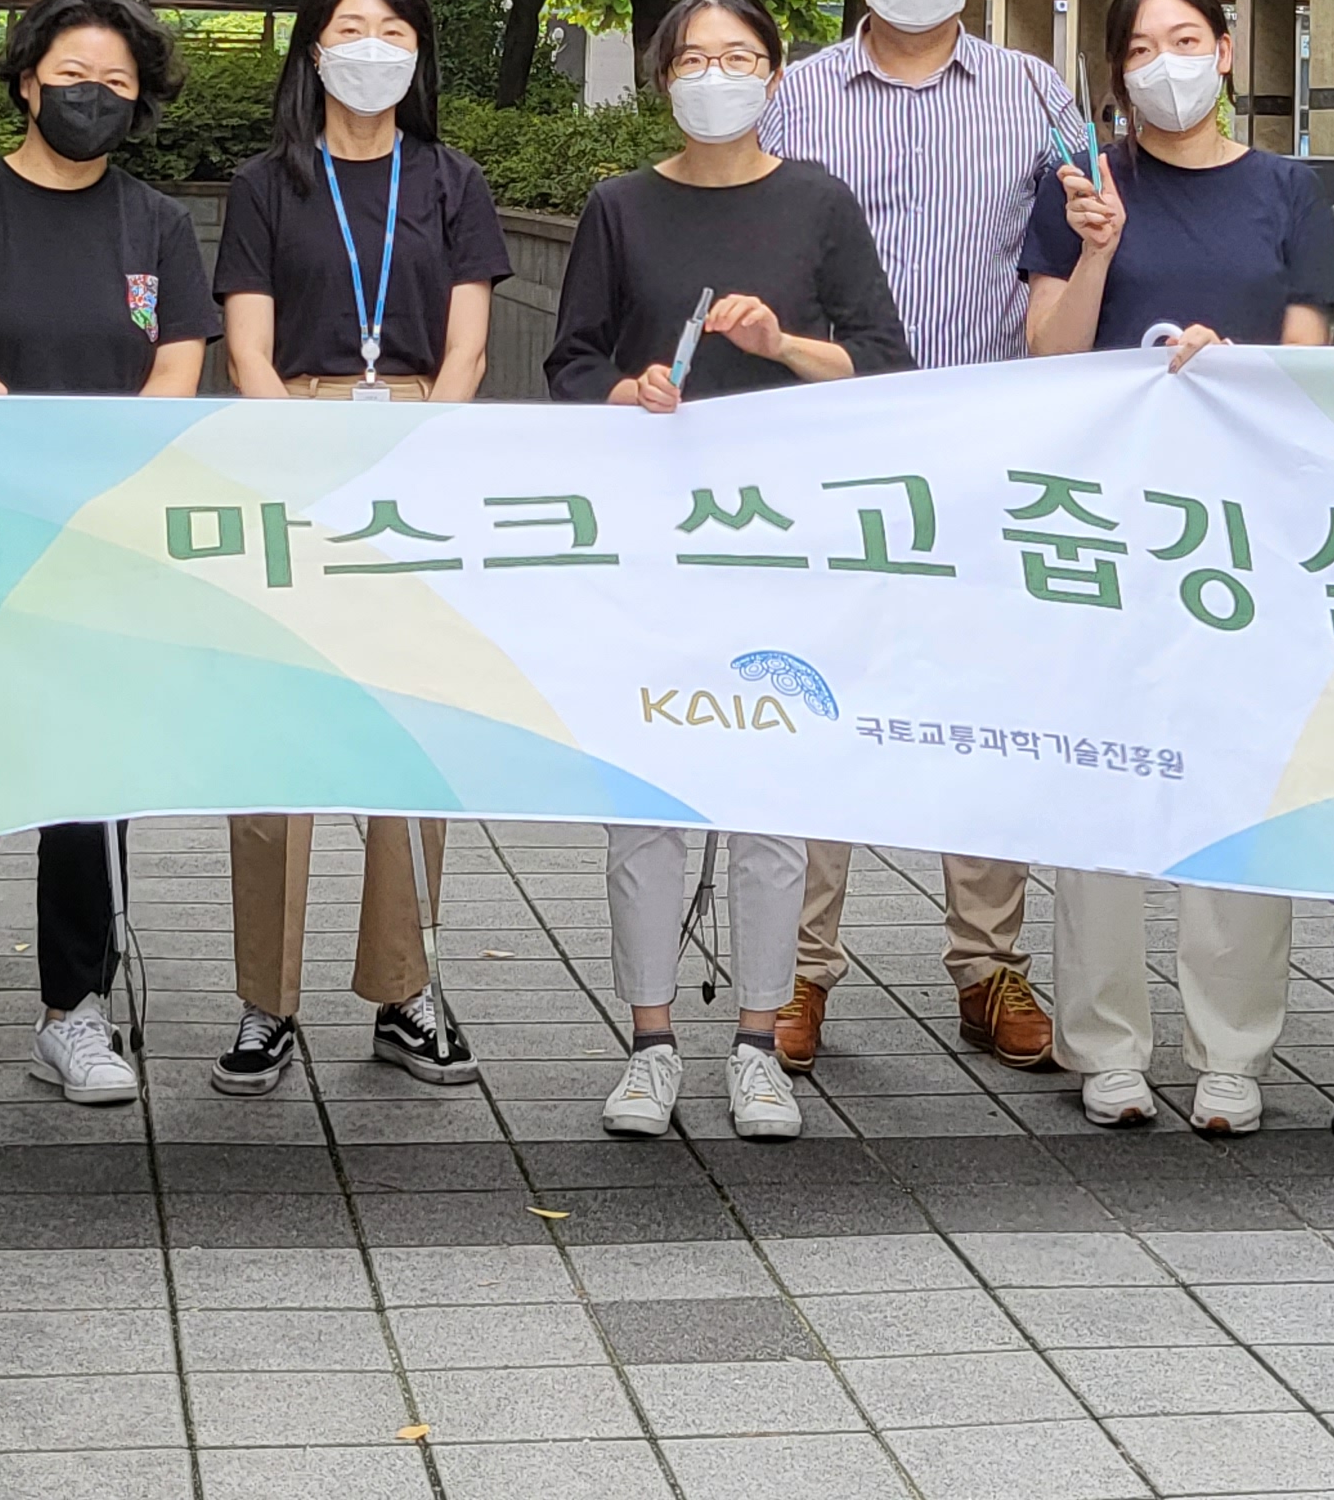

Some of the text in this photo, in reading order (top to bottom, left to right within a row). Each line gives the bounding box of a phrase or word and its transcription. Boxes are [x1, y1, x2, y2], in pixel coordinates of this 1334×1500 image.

[165, 495, 620, 588] 마스크
[675, 474, 957, 577] 쓰고
[1002, 470, 1255, 632] 줍깅
[640, 687, 797, 733] KAIA
[856, 716, 1185, 781] 국토교통과학기술진흥원
